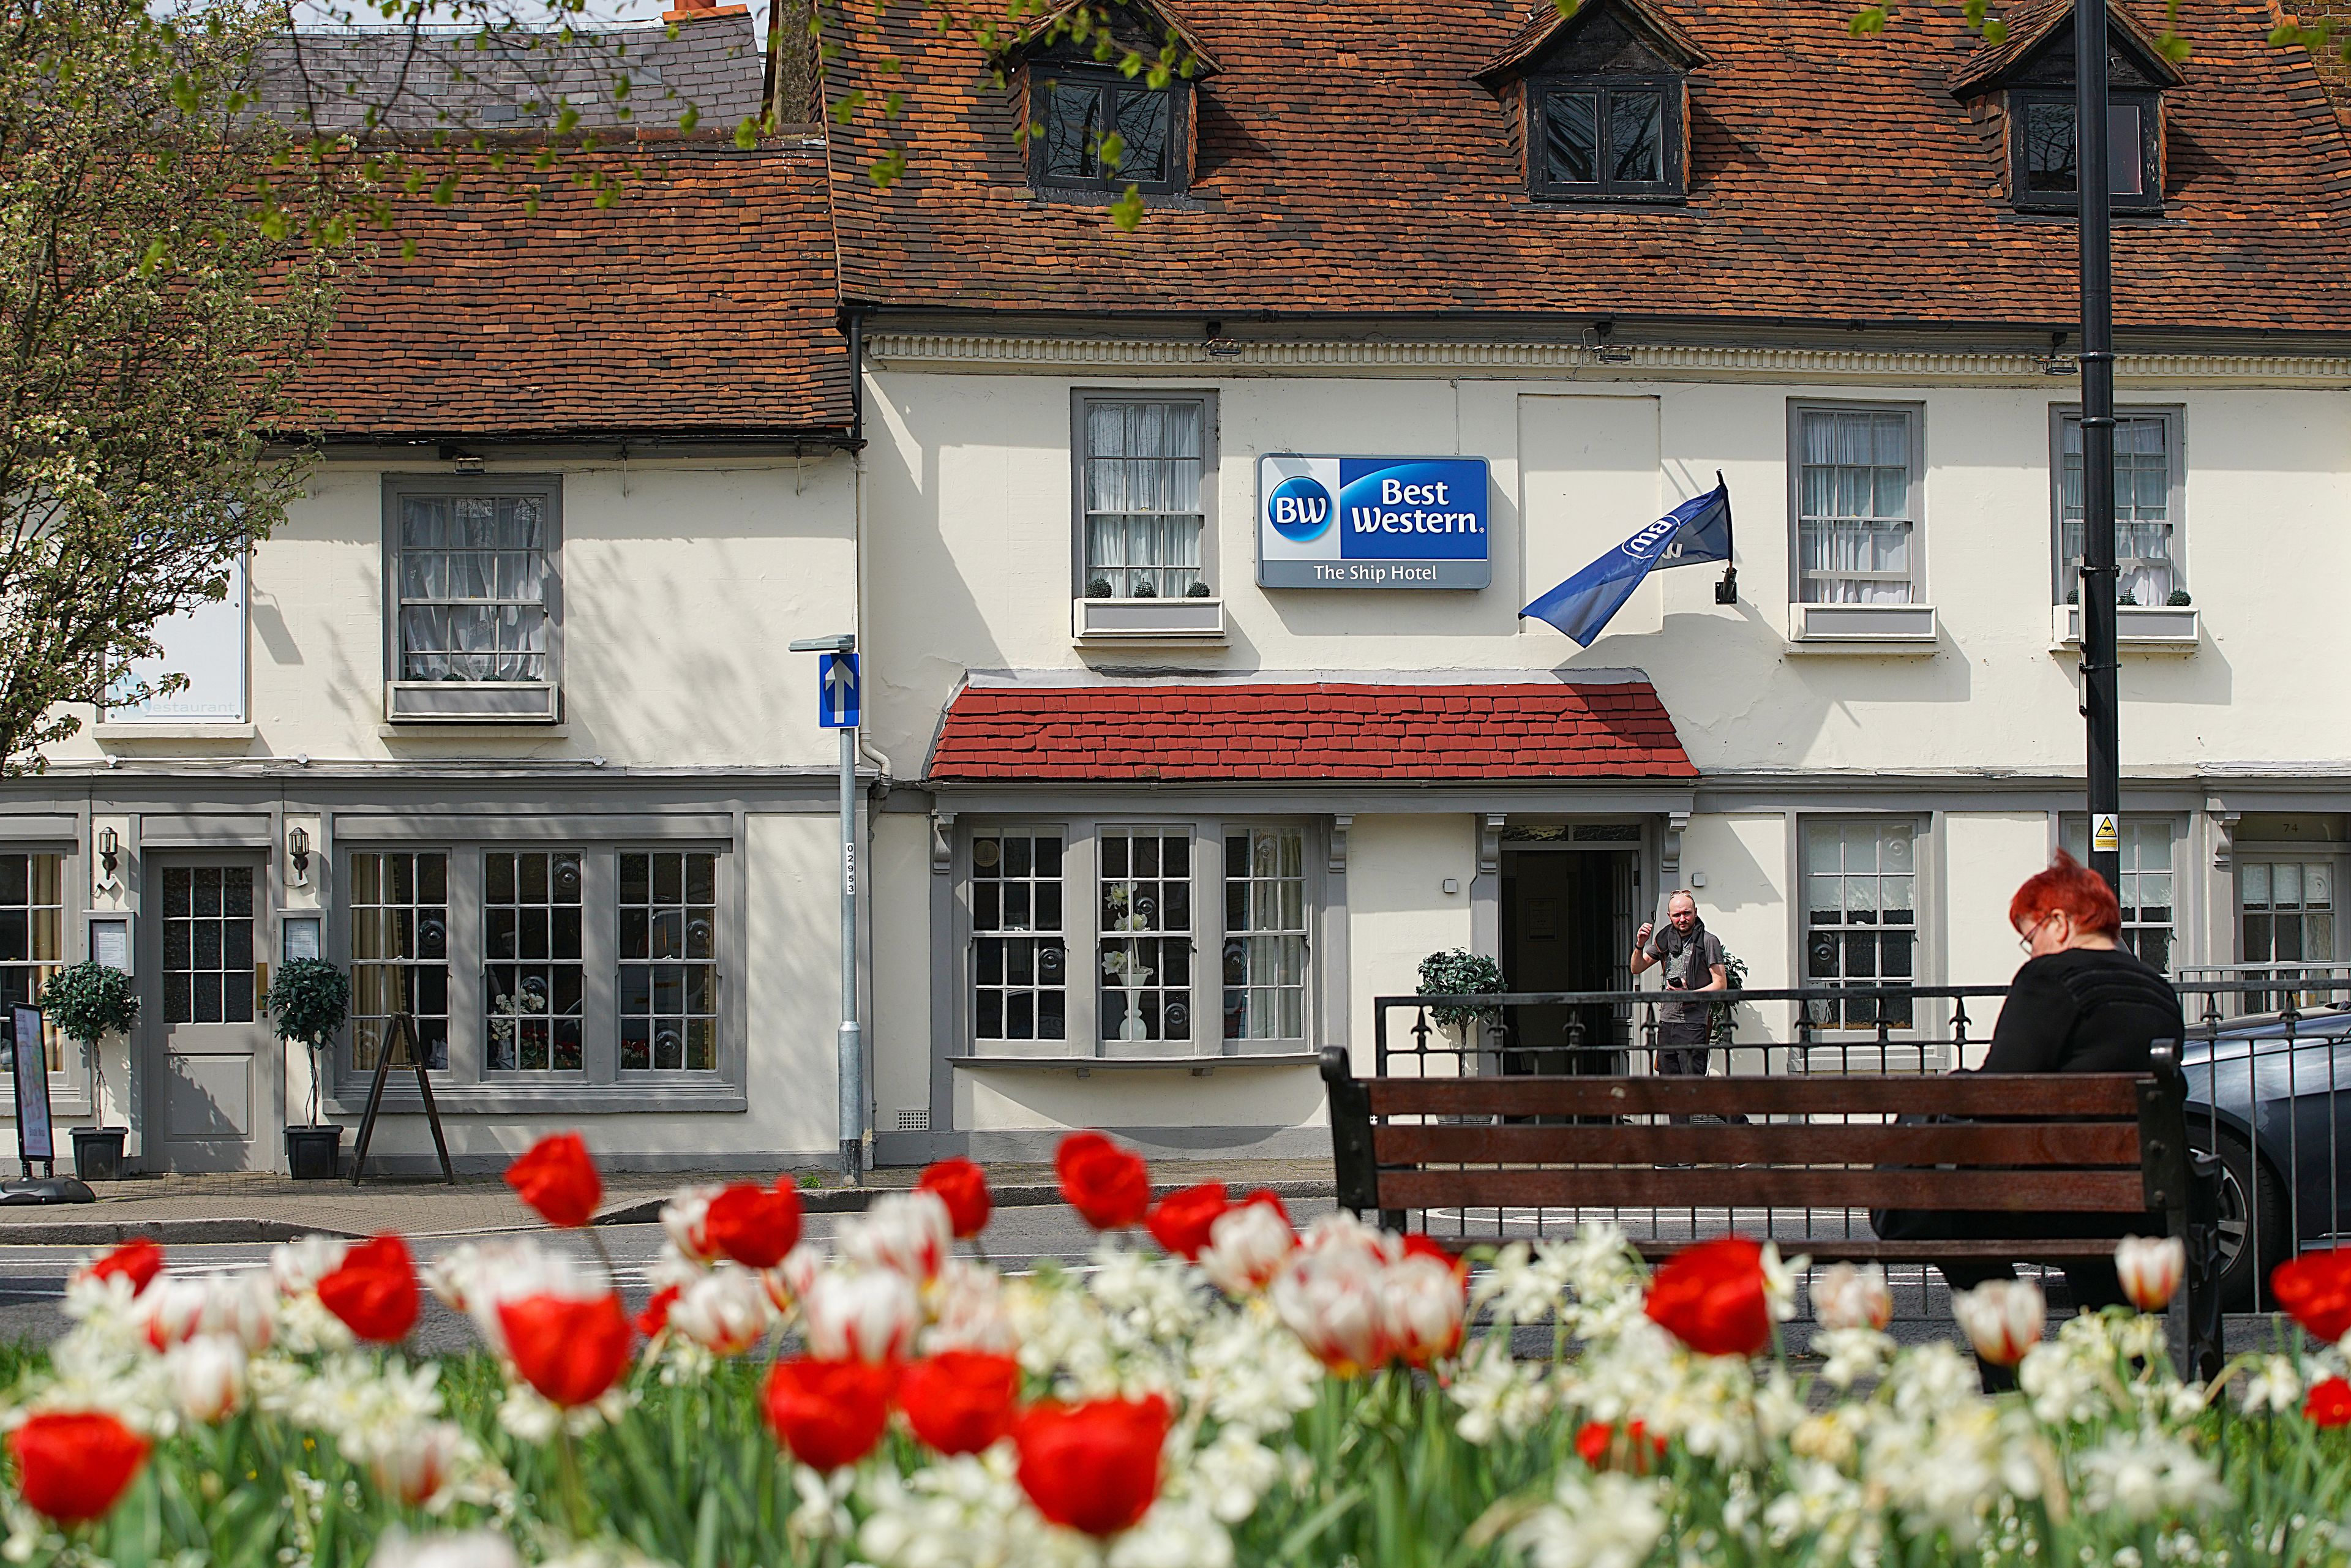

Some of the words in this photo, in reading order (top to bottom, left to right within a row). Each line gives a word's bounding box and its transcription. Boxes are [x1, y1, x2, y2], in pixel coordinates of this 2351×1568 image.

[1382, 479, 1449, 505] Best
[1276, 497, 1327, 524] BW
[1352, 507, 1478, 534] Western
[1630, 520, 1673, 552] BW
[1314, 565, 1344, 580] The
[1349, 565, 1386, 583] Ship
[1391, 565, 1438, 580] Hotel
[2283, 823, 2298, 833] 74
